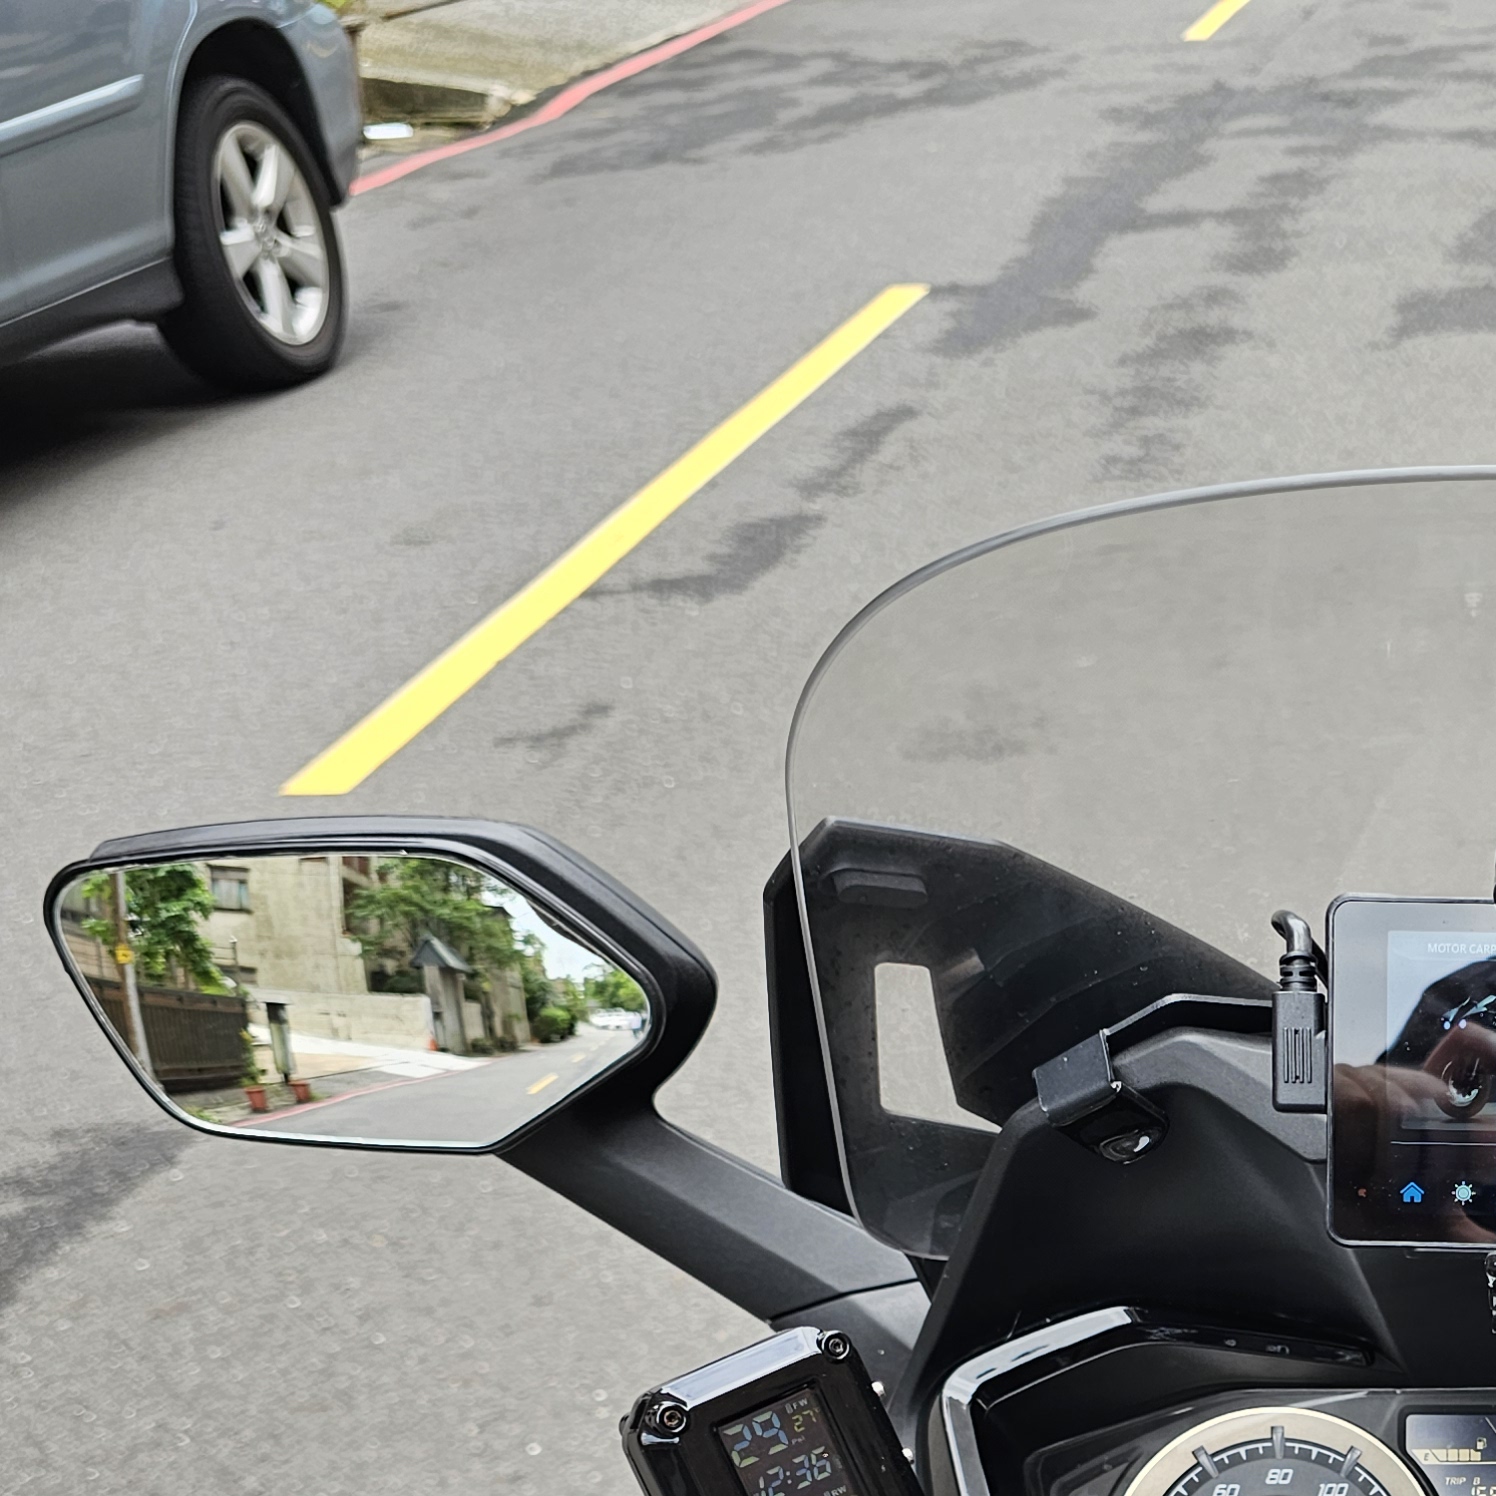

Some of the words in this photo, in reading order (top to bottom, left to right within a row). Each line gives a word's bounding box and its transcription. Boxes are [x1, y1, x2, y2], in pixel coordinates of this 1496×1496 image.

[1427, 943, 1467, 955] MOTOR
[792, 1398, 808, 1410] FW
[723, 1410, 789, 1468] 29
[1423, 1452, 1430, 1461] E
[1265, 1469, 1293, 1484] 80
[1445, 1477, 1466, 1485] TRIP
[1473, 1477, 1480, 1485] B
[831, 1485, 847, 1496] RW
